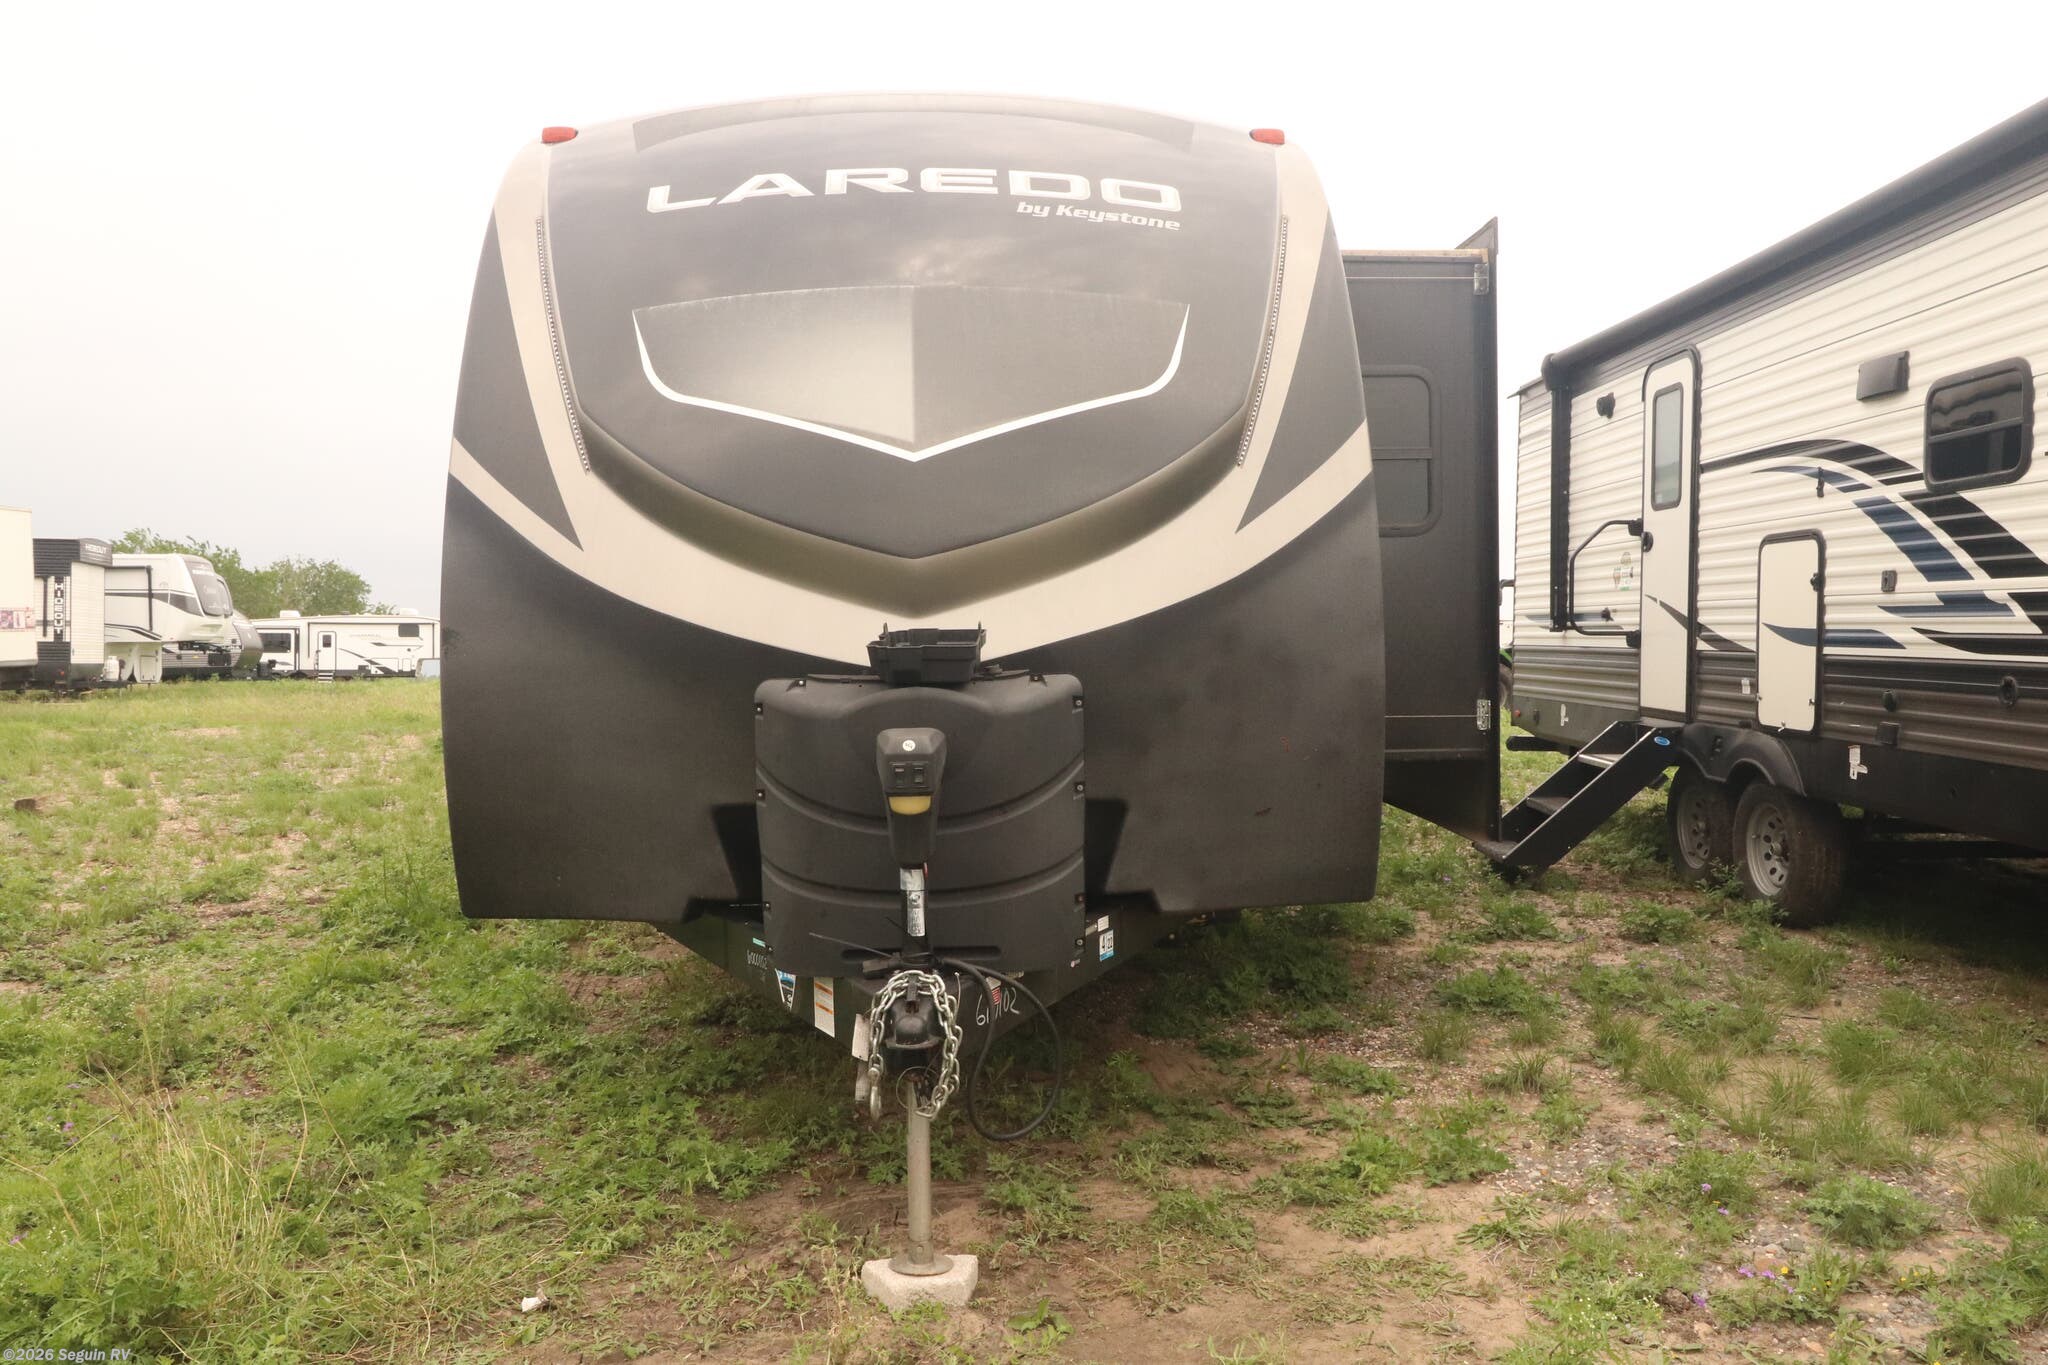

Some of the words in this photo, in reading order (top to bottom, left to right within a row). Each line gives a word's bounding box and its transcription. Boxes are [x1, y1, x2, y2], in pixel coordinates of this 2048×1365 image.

[646, 166, 1182, 214] LAREDO
[1016, 201, 1051, 217] by
[1055, 204, 1181, 231] Keystone
[53, 582, 64, 635] HIDEOUT
